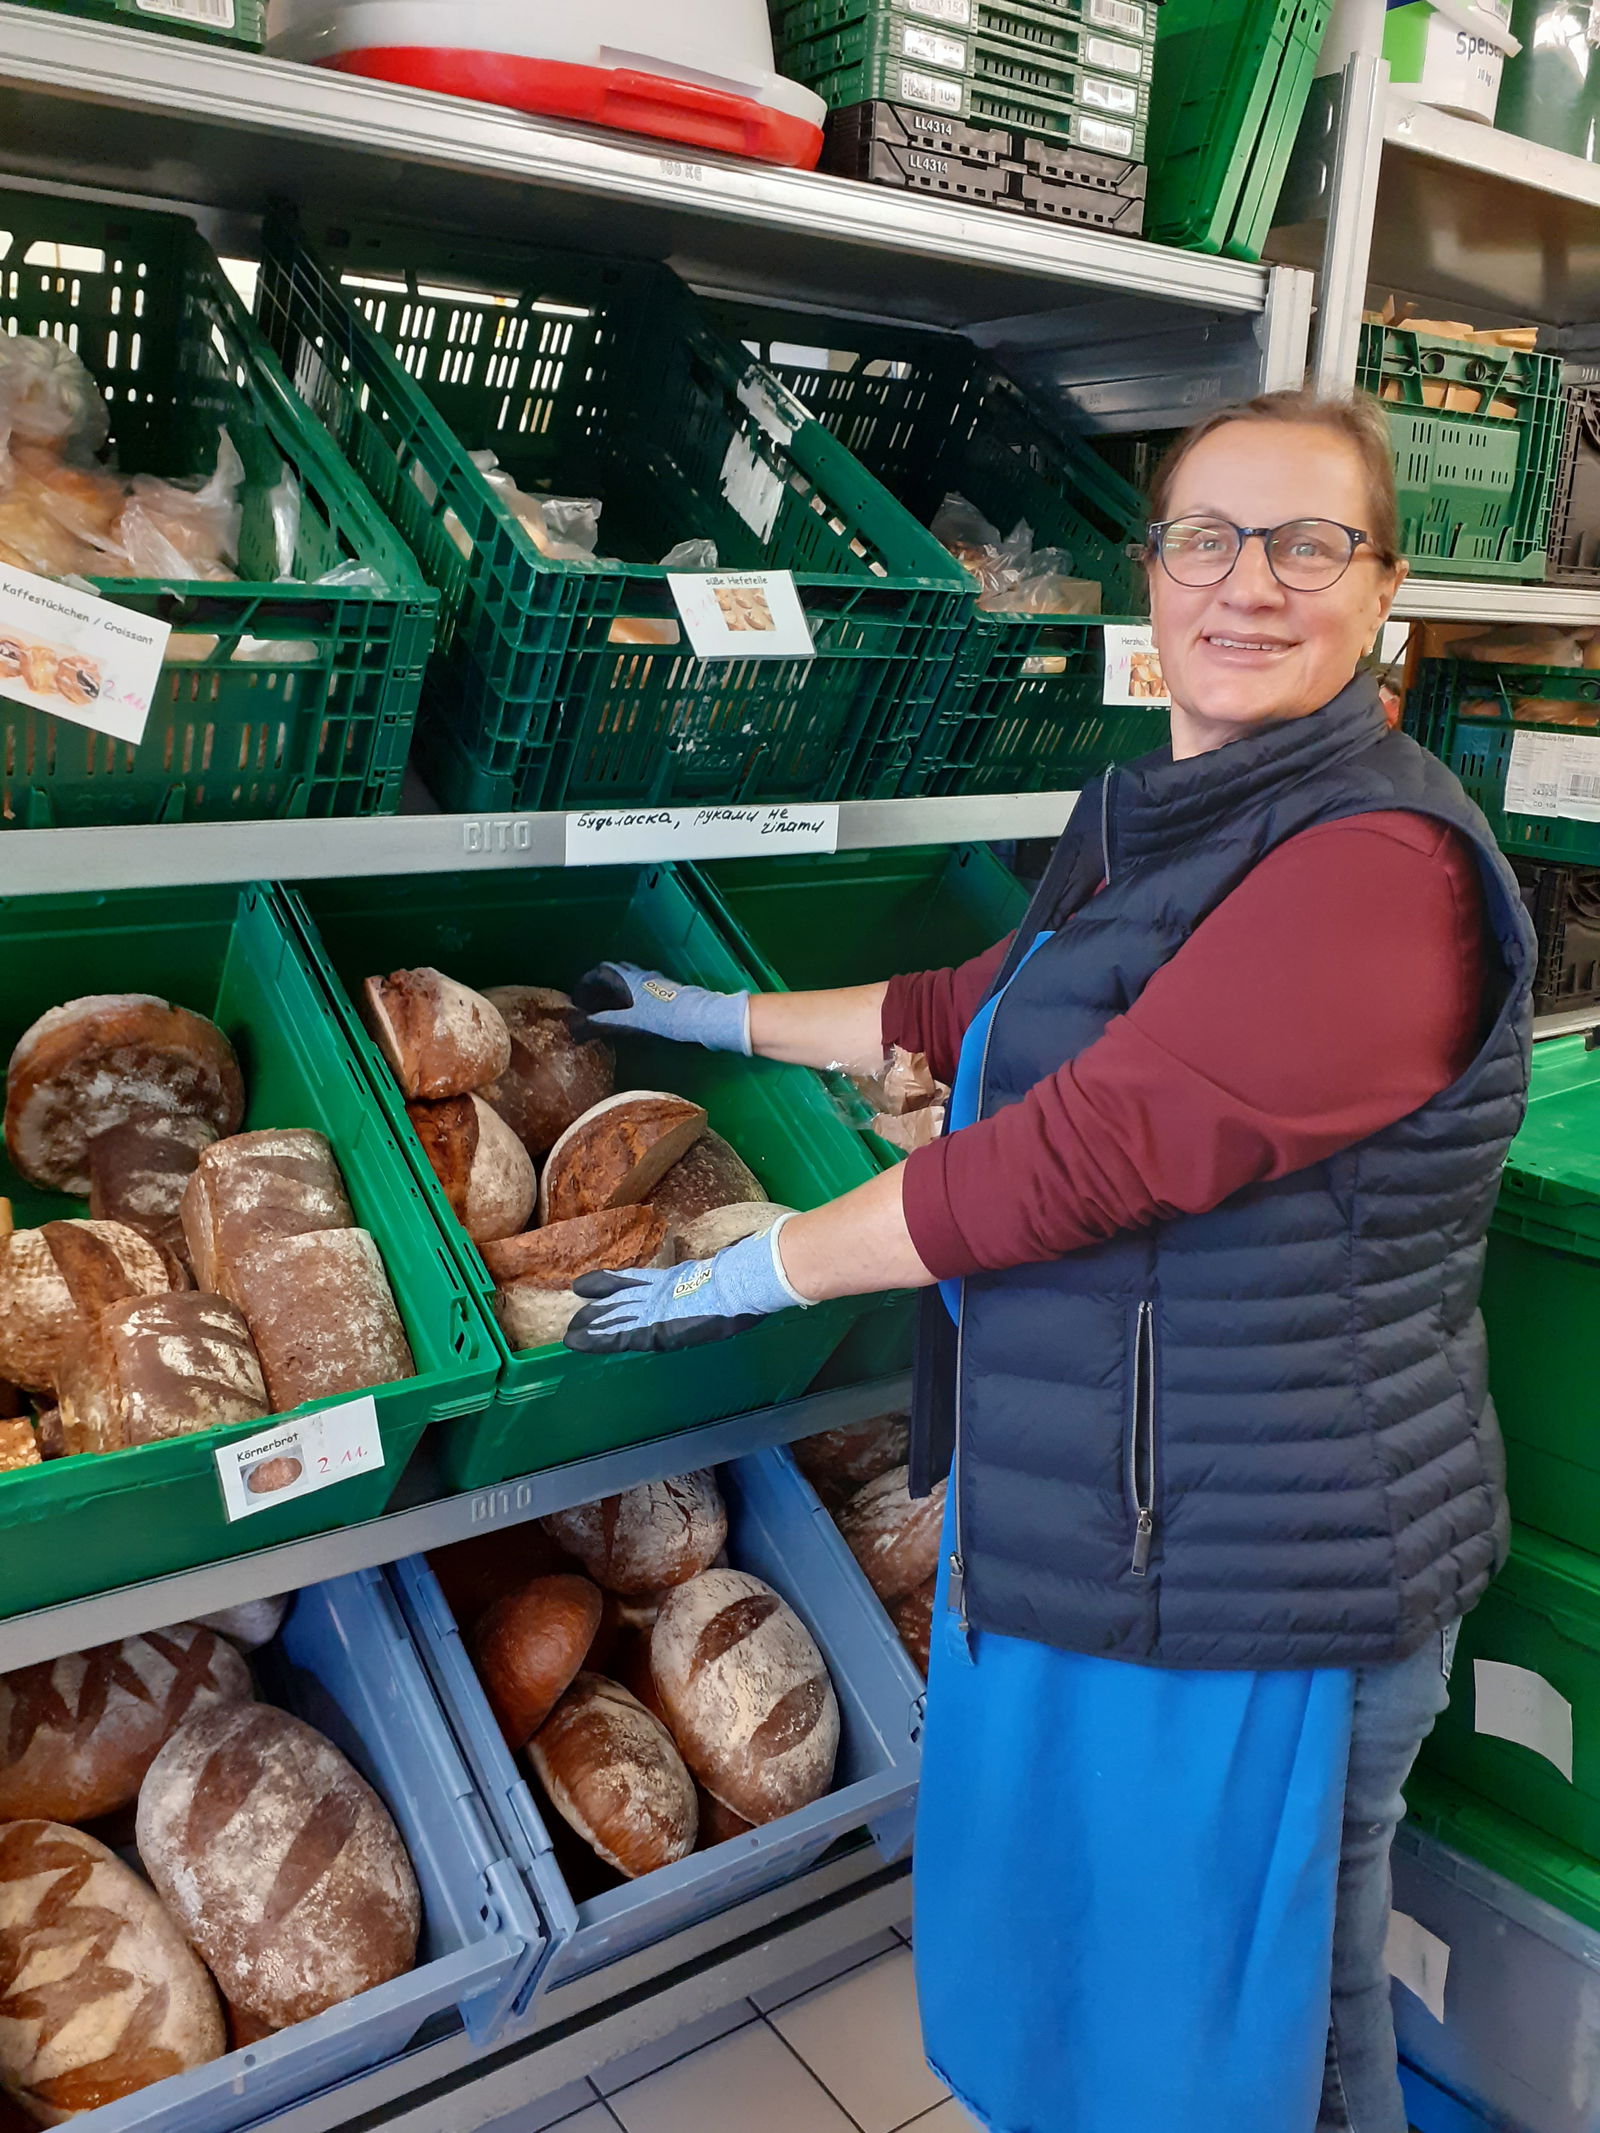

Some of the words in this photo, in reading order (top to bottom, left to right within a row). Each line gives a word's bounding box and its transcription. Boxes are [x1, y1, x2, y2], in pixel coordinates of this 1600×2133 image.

[914, 116, 952, 136] LL4314
[909, 154, 949, 175] LL4314
[728, 575, 769, 585] Hefeteile
[2, 582, 90, 623] Kaffestückchen
[103, 620, 154, 646] Croissant
[694, 809, 760, 826] руками
[767, 807, 789, 820] не
[236, 1432, 299, 1463] Körnerbrot
